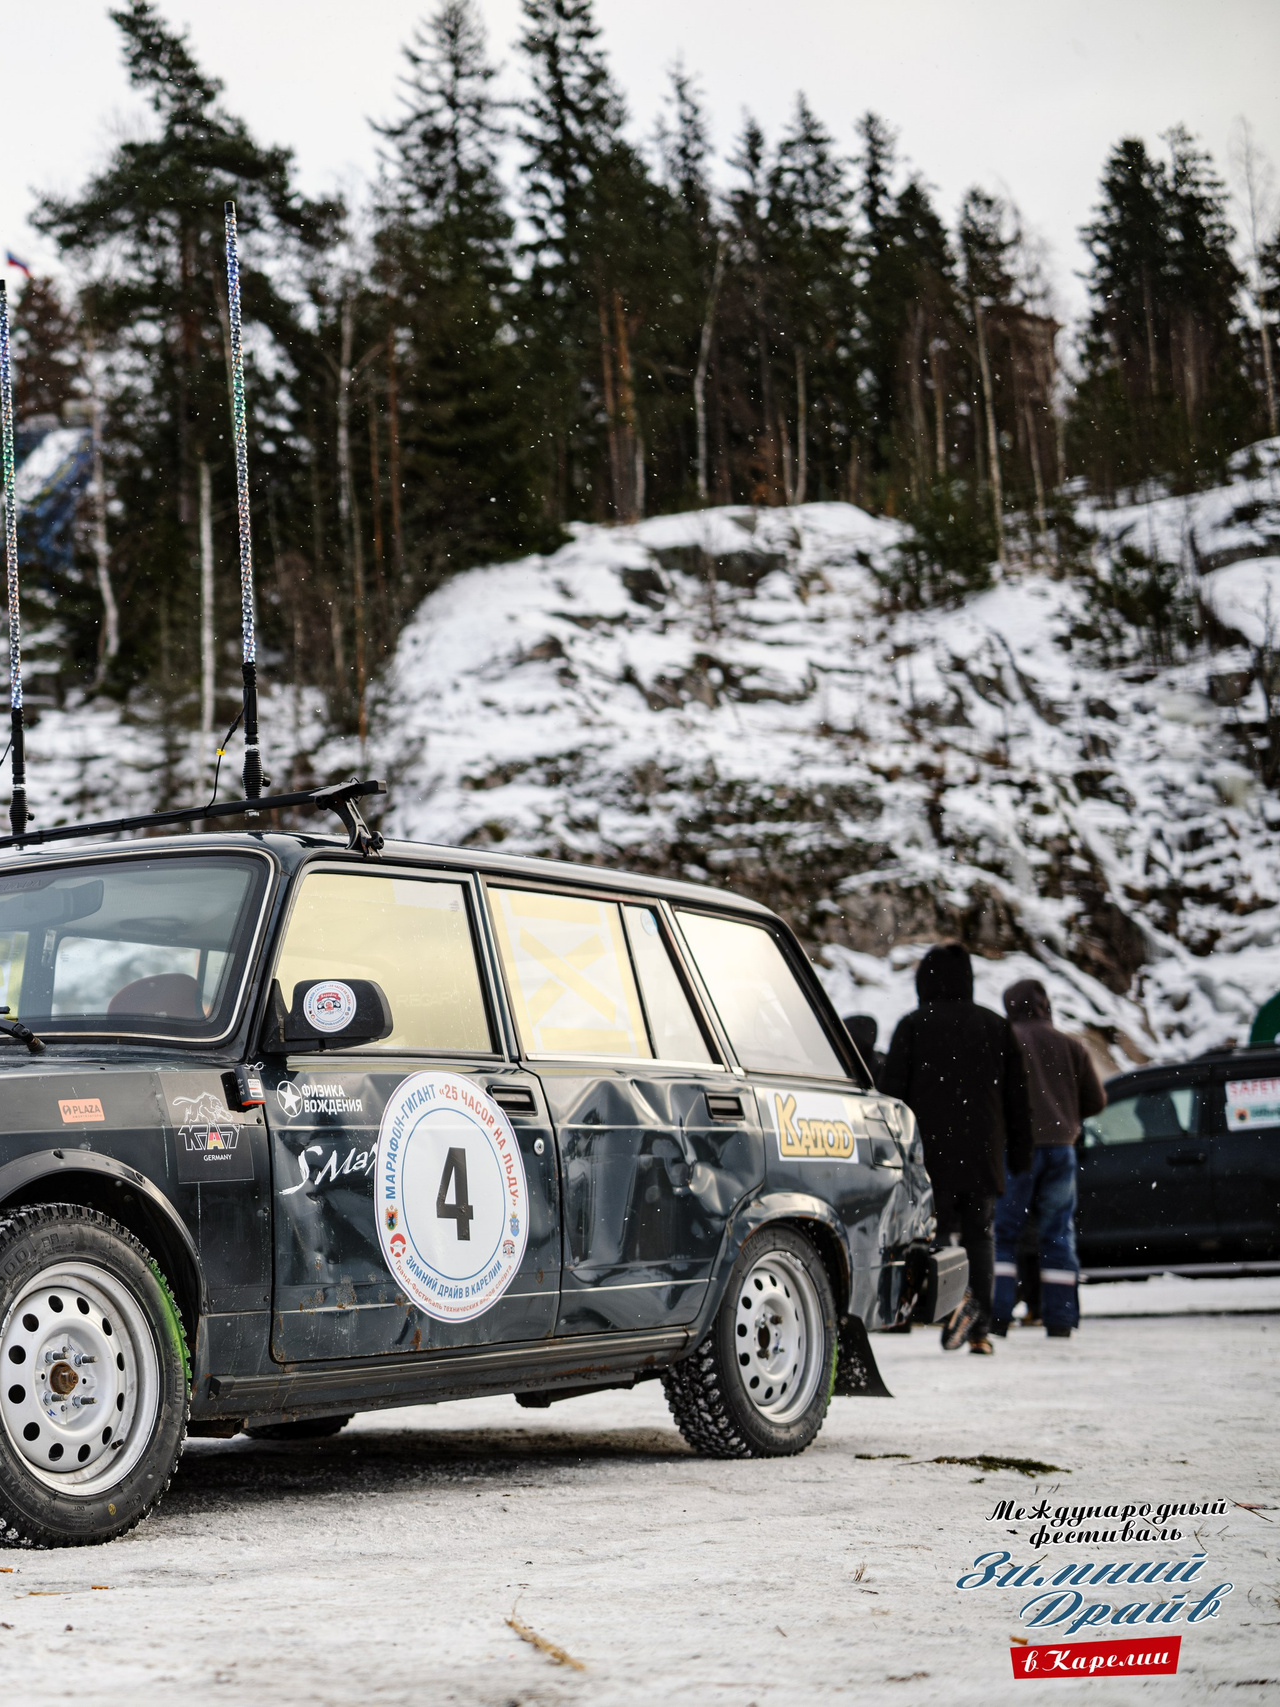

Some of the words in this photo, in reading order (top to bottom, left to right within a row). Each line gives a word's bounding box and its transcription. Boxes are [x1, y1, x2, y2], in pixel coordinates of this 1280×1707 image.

[301, 1083, 345, 1098] ФИЗИКА
[1229, 1079, 1280, 1096] SAFET
[73, 1104, 101, 1114] PLAZA
[304, 1098, 363, 1116] ВОЖДЕНИЯ
[774, 1092, 855, 1159] KATOD
[385, 1084, 436, 1200] МАРАФОН-ГИГАНТ
[438, 1084, 458, 1101] «25
[461, 1090, 495, 1129] ЧАСОВ
[493, 1127, 507, 1150] НА
[502, 1152, 520, 1207] ЛЬДУ»
[203, 1154, 232, 1162] GERMANY
[436, 1147, 474, 1241] 4
[406, 1255, 437, 1292] ЗИМНИЙ
[437, 1285, 463, 1299] ДРАЙВ
[465, 1287, 470, 1298] В
[471, 1259, 503, 1296] КАРЕЛИИ
